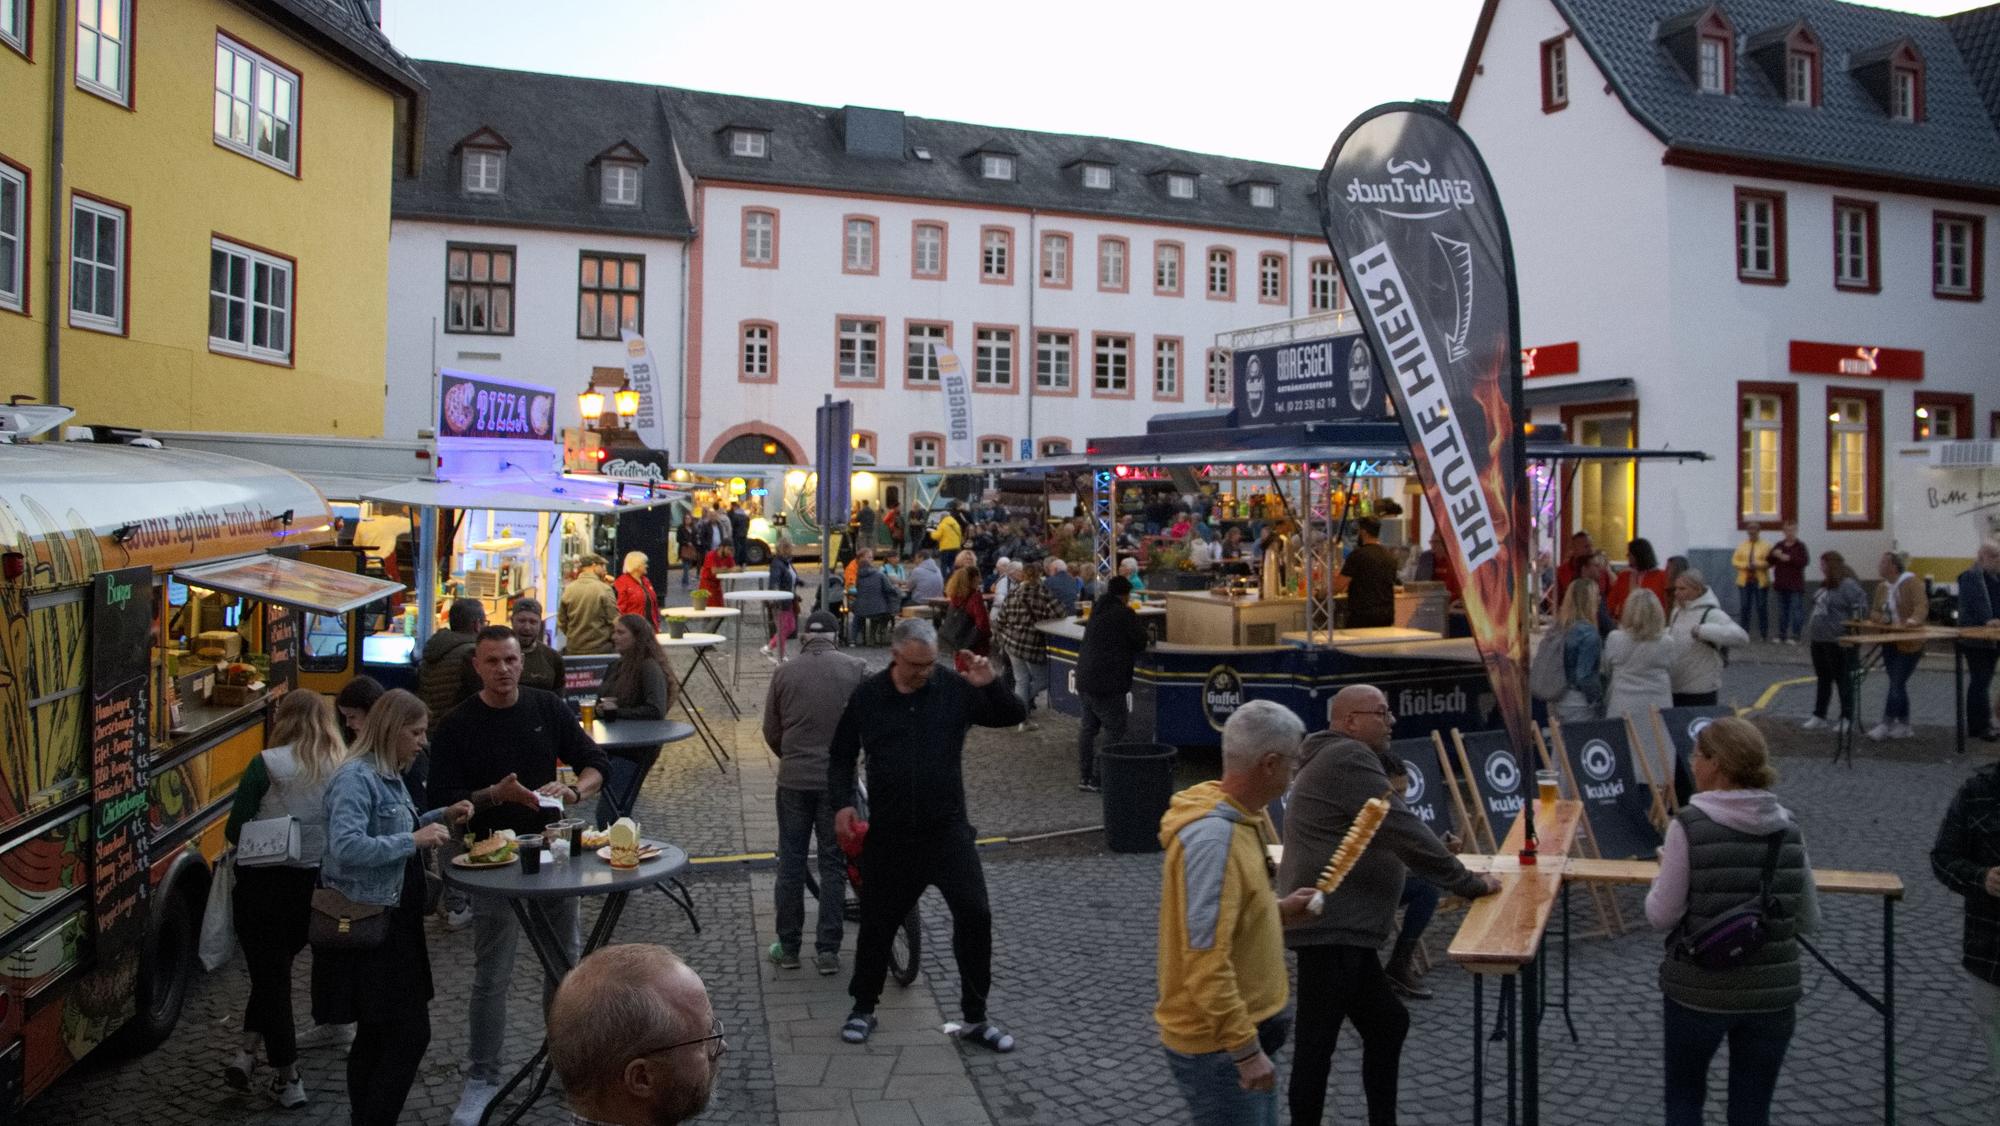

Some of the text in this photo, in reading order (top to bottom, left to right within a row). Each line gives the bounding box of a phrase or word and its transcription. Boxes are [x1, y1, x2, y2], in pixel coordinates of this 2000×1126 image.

[477, 389, 529, 433] PIZZA
[106, 574, 132, 610] Burger
[1207, 691, 1240, 705] Gaffel
[1399, 685, 1466, 716] Kölsch
[1585, 778, 1625, 800] kukki
[1488, 795, 1525, 813] kukk
